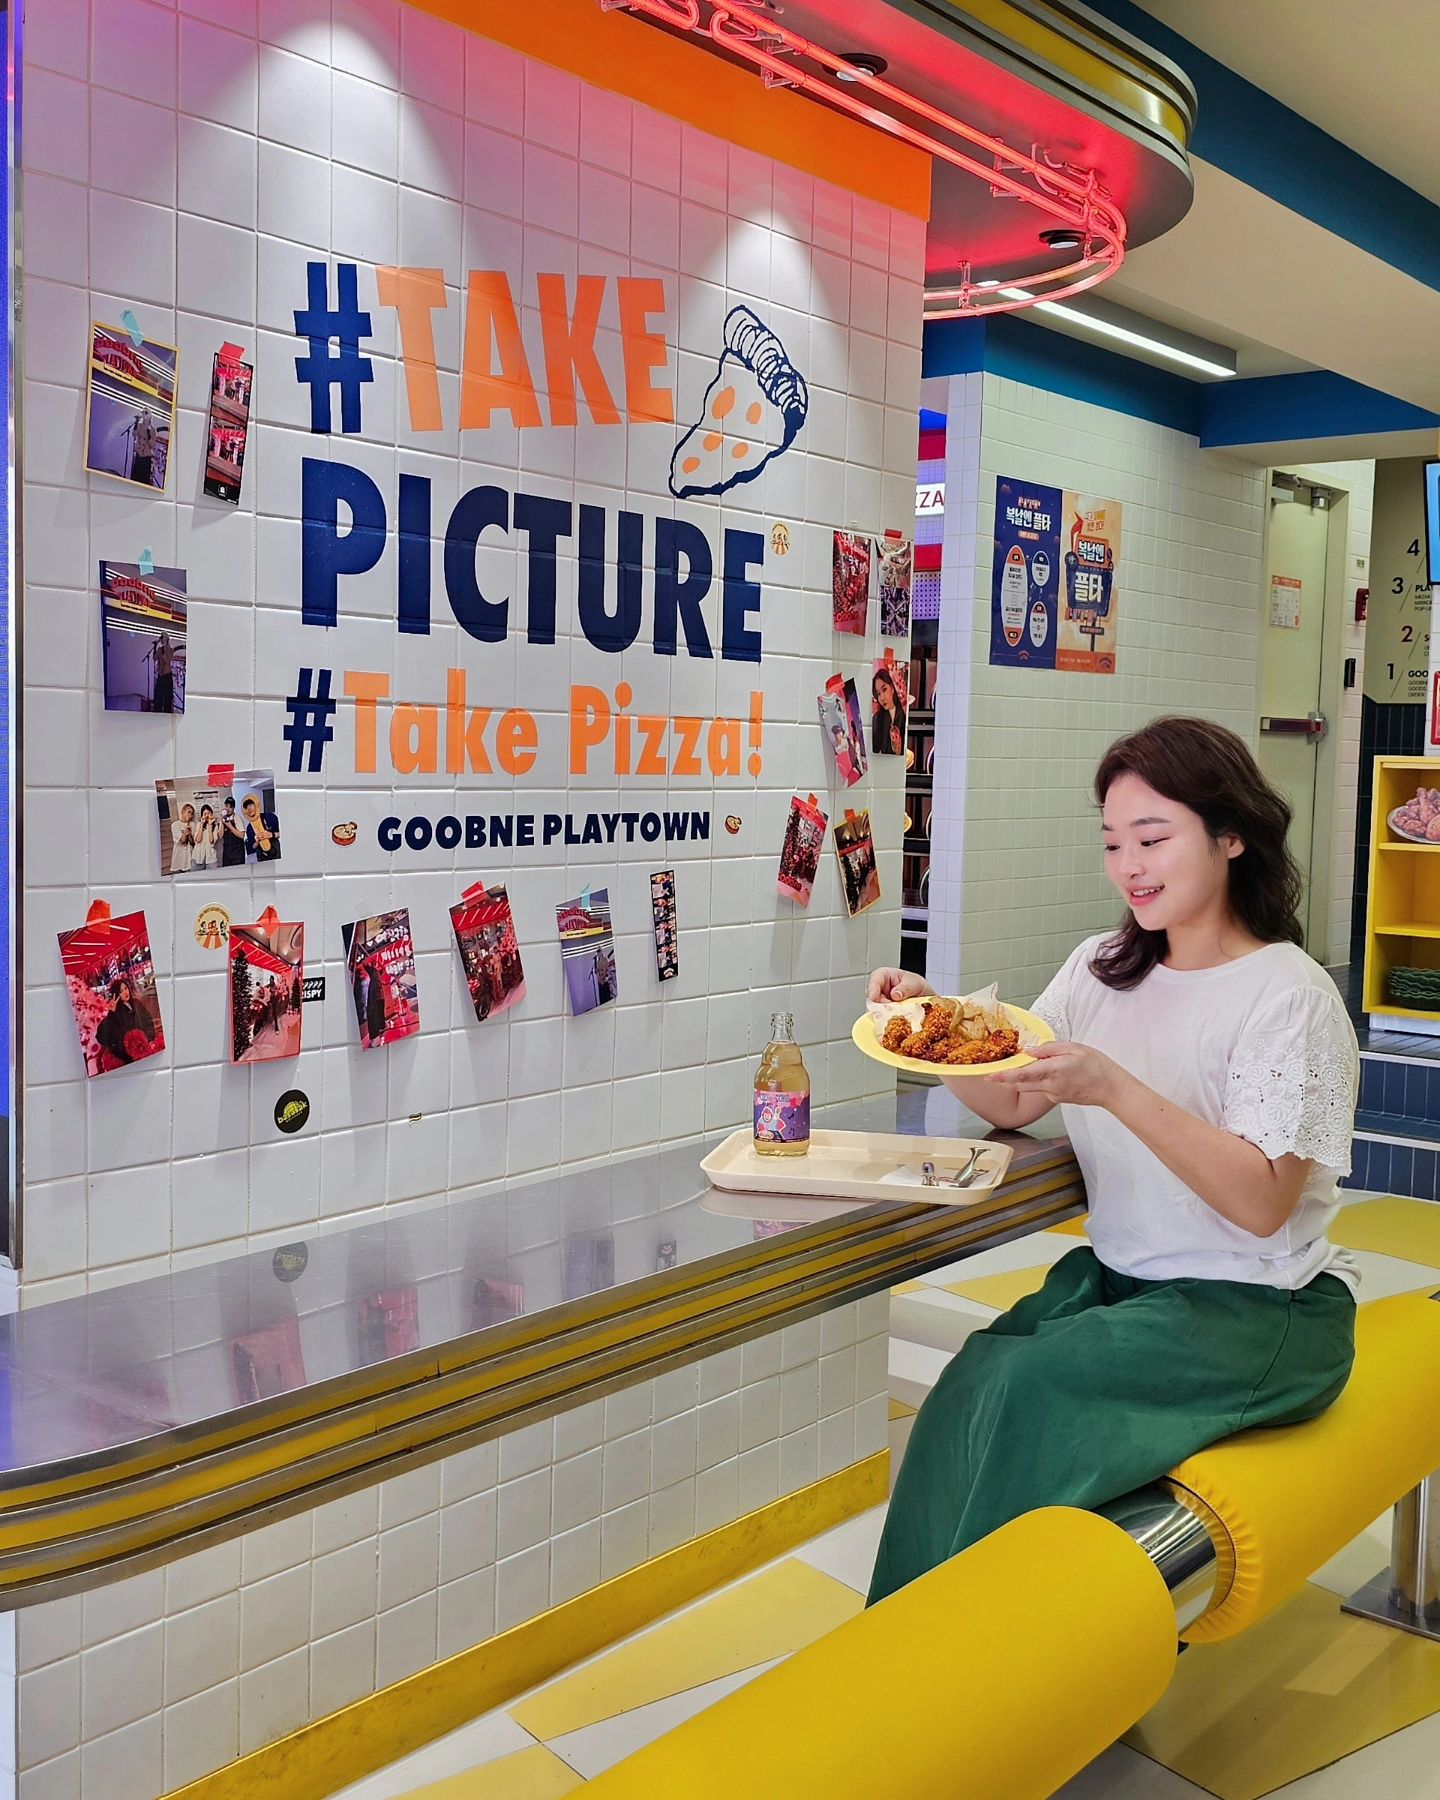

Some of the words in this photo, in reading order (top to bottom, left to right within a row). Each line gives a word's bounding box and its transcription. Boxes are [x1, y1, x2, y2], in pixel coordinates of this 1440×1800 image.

[294, 262, 674, 434] #TAKE
[915, 490, 944, 508] ZA
[1406, 539, 1420, 556] 4
[302, 457, 764, 662] PICTURE
[1391, 577, 1404, 594] 3
[1401, 625, 1413, 643] 2
[1387, 663, 1395, 680] 1
[283, 668, 538, 775] #Take
[570, 681, 764, 776] Pizza!
[378, 815, 534, 851] GOOBNE
[543, 812, 710, 845] PLAYTOWN
[302, 989, 322, 999] ISPY
